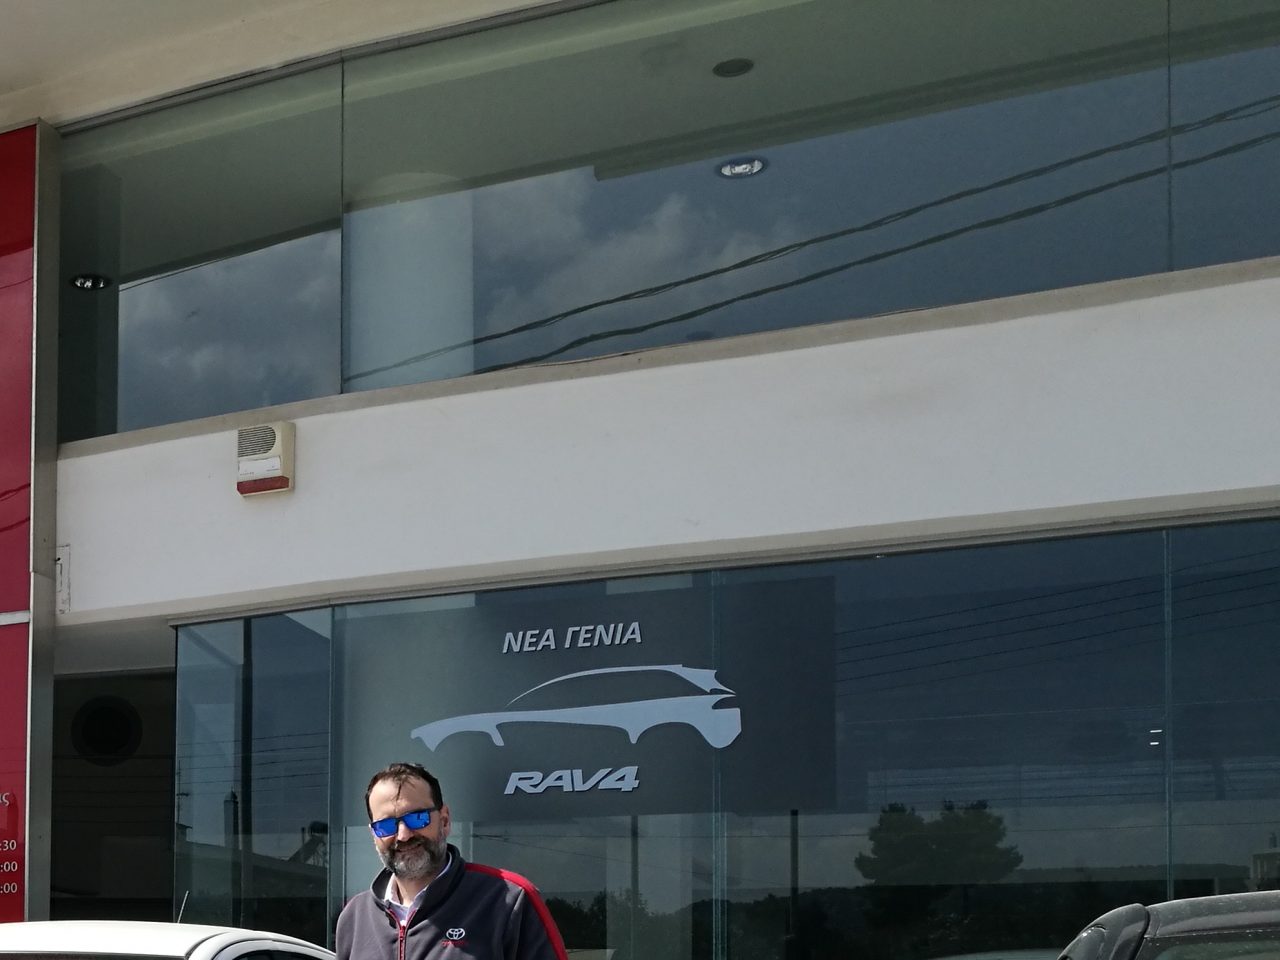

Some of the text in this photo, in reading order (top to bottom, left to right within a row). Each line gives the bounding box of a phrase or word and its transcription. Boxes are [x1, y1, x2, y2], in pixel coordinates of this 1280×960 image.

[502, 621, 643, 653] ΝΕΑ ΓΕΝΙΑ
[504, 765, 640, 795] RAV4
